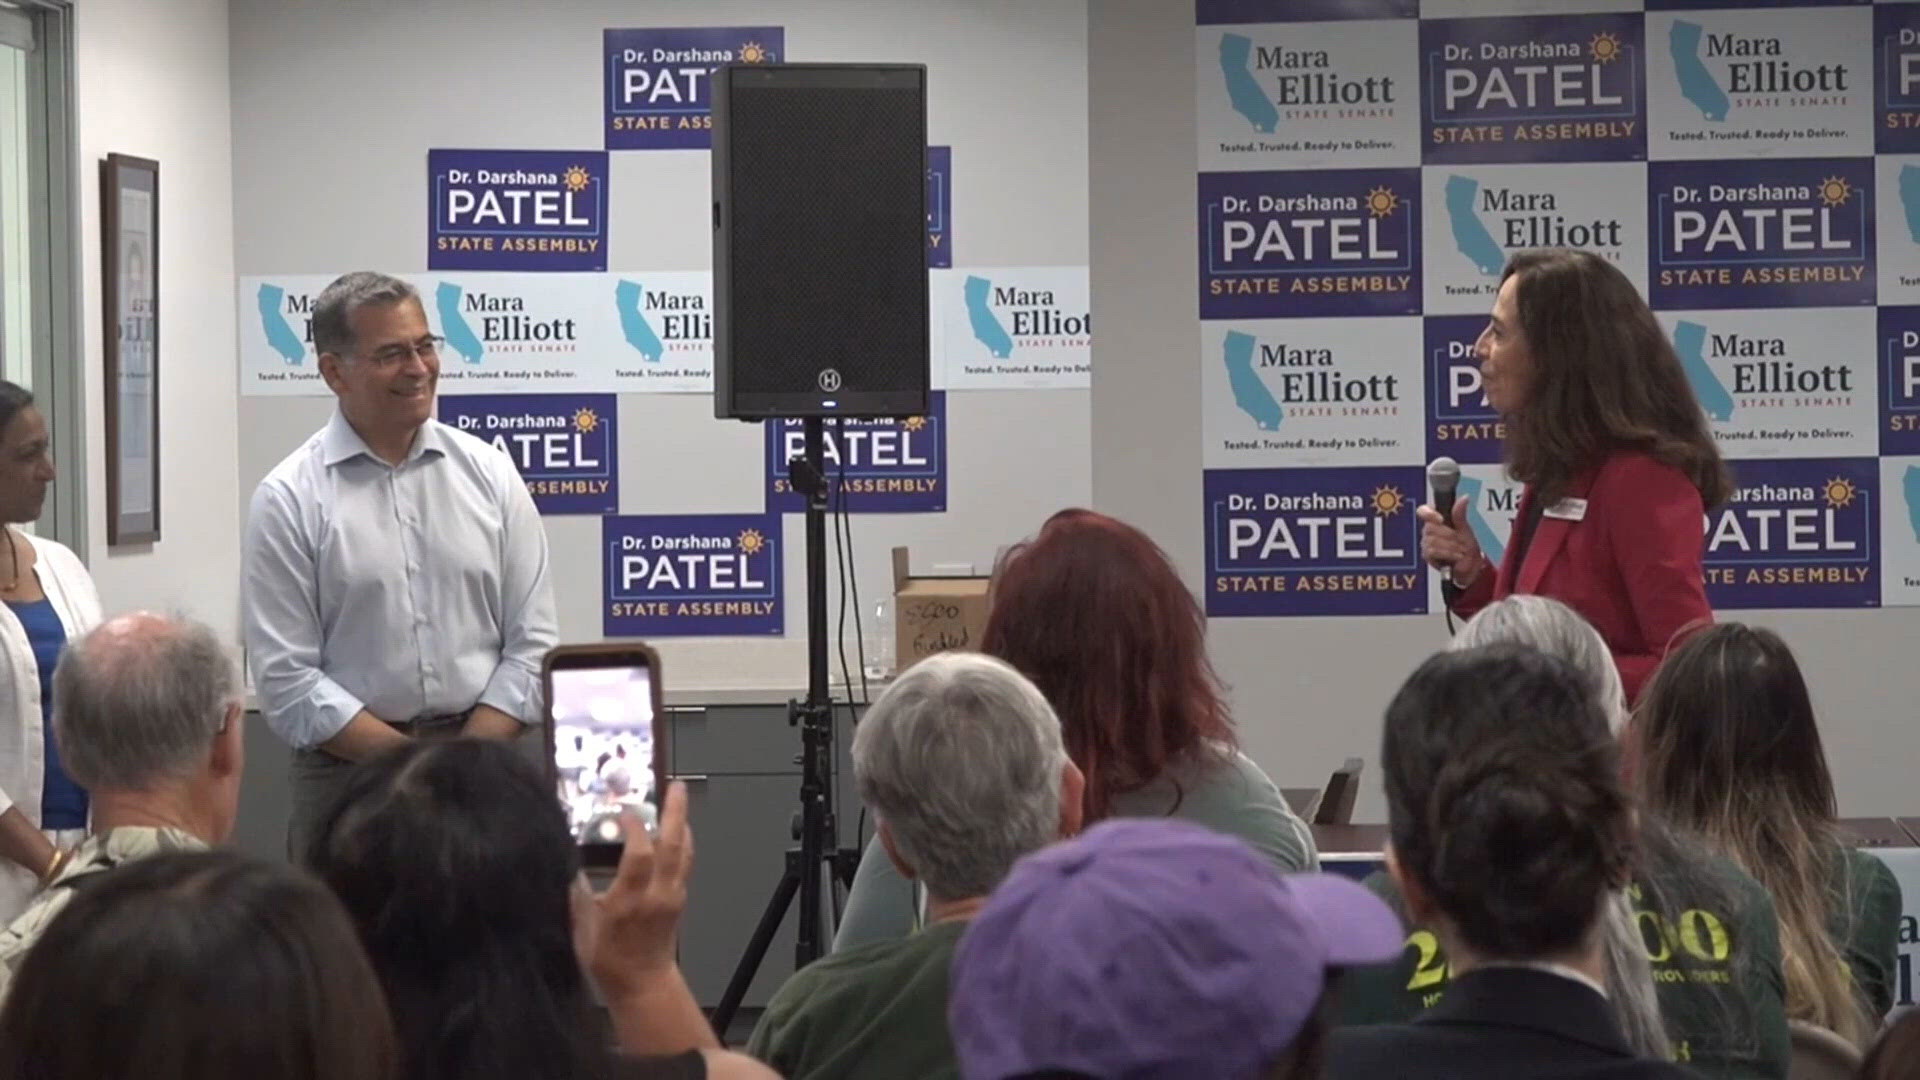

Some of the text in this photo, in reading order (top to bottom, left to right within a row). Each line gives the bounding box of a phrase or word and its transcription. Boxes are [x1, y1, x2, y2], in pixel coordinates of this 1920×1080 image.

[1443, 41, 1581, 61] Dr. Darshana
[1706, 33, 1781, 57] Mara
[623, 47, 733, 63] Dr. Darshana
[1256, 46, 1330, 70] Mara
[624, 68, 717, 104] PAT
[1728, 61, 1849, 93] Elliott
[1277, 73, 1396, 106] Elliott
[1445, 64, 1623, 111] PATEL
[1736, 97, 1848, 108] STATE SENATE
[613, 116, 671, 130] STATE
[1285, 108, 1395, 120] STATE SENATE
[1433, 121, 1636, 144] STATE ASSEMBLY
[1669, 129, 1848, 141] Tested. Trusted. Ready to Deliver.
[1220, 140, 1396, 153] Tested. Trusted. Ready to Deliver.
[449, 169, 558, 185] Dr. Darshana
[1482, 188, 1556, 212] Mara
[1673, 183, 1810, 204] Dr. Darshana
[449, 189, 589, 225] PATEL
[1222, 193, 1357, 214] Dr. Darshana
[1223, 217, 1398, 262] PATEL
[1504, 216, 1623, 248] Elliott
[1673, 207, 1851, 253] PATEL
[437, 236, 599, 252] STATE ASSEMBLY
[1660, 265, 1865, 285] STATE ASSEMBLY
[1210, 276, 1411, 295] STATE ASSEMBLY
[1445, 285, 1482, 296] Tested.
[465, 293, 524, 312] Mara
[645, 291, 704, 310] Mara
[994, 287, 1054, 306] Mara
[483, 316, 577, 341] Elliott
[488, 344, 577, 353] STATE SENATE
[668, 343, 704, 352] STATE
[1018, 339, 1054, 347] STATE
[1711, 334, 1785, 358] Mara
[1260, 344, 1333, 367] Mara
[503, 369, 531, 381] Ready
[533, 370, 542, 378] to
[1033, 365, 1061, 375] Ready
[1063, 365, 1072, 373] to
[1733, 361, 1853, 394] Elliott
[1281, 371, 1399, 403] Elliott
[1450, 365, 1491, 408] P
[1289, 406, 1399, 417] STATE SENATE
[1741, 397, 1852, 408] STATE SENATE
[458, 413, 566, 429] Dr. Darshana
[1437, 424, 1507, 440] STATE
[1713, 429, 1854, 441] Trusted. Ready to Deliver.
[1224, 438, 1400, 450] Tested. Trusted. Ready to Deliver.
[840, 479, 937, 493] ASSEMBLY
[1228, 492, 1363, 511] Dr. Darshana
[622, 534, 732, 550] Dr. Darshana
[1229, 516, 1404, 560] PATEL
[623, 554, 764, 590] PATEL
[1746, 567, 1869, 584] ASSEMBLY
[1216, 574, 1417, 592] STATE ASSEMBLY
[612, 602, 775, 616] STATE ASSEMBLY
